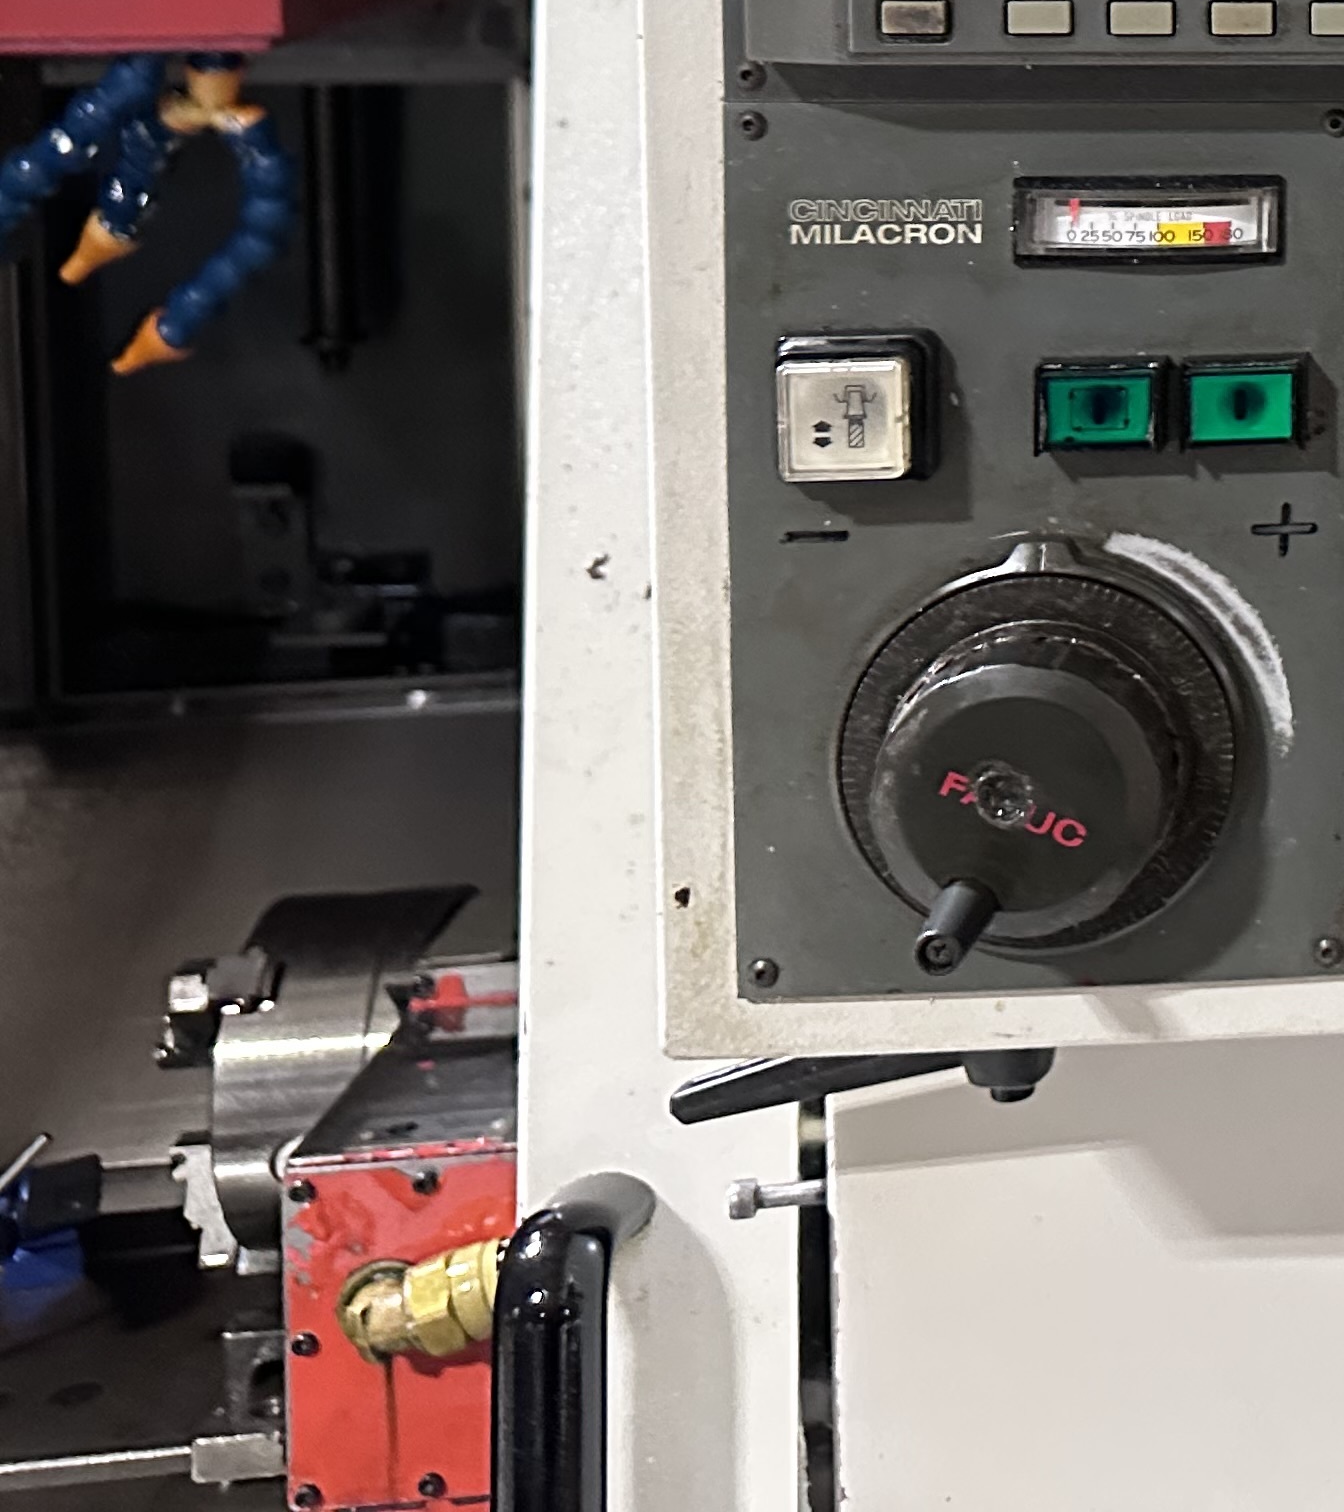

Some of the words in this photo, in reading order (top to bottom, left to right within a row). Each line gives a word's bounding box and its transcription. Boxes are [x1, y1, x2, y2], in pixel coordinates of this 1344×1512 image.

[789, 199, 982, 223] CINCINNATI
[790, 223, 983, 245] MILACRON
[1066, 229, 1077, 242] 0
[1081, 230, 1100, 242] 25
[1101, 230, 1123, 242] 50
[1126, 230, 1146, 242] 75
[1150, 230, 1175, 242] 100
[1188, 229, 1214, 241] 150
[939, 771, 1087, 848] FUC
